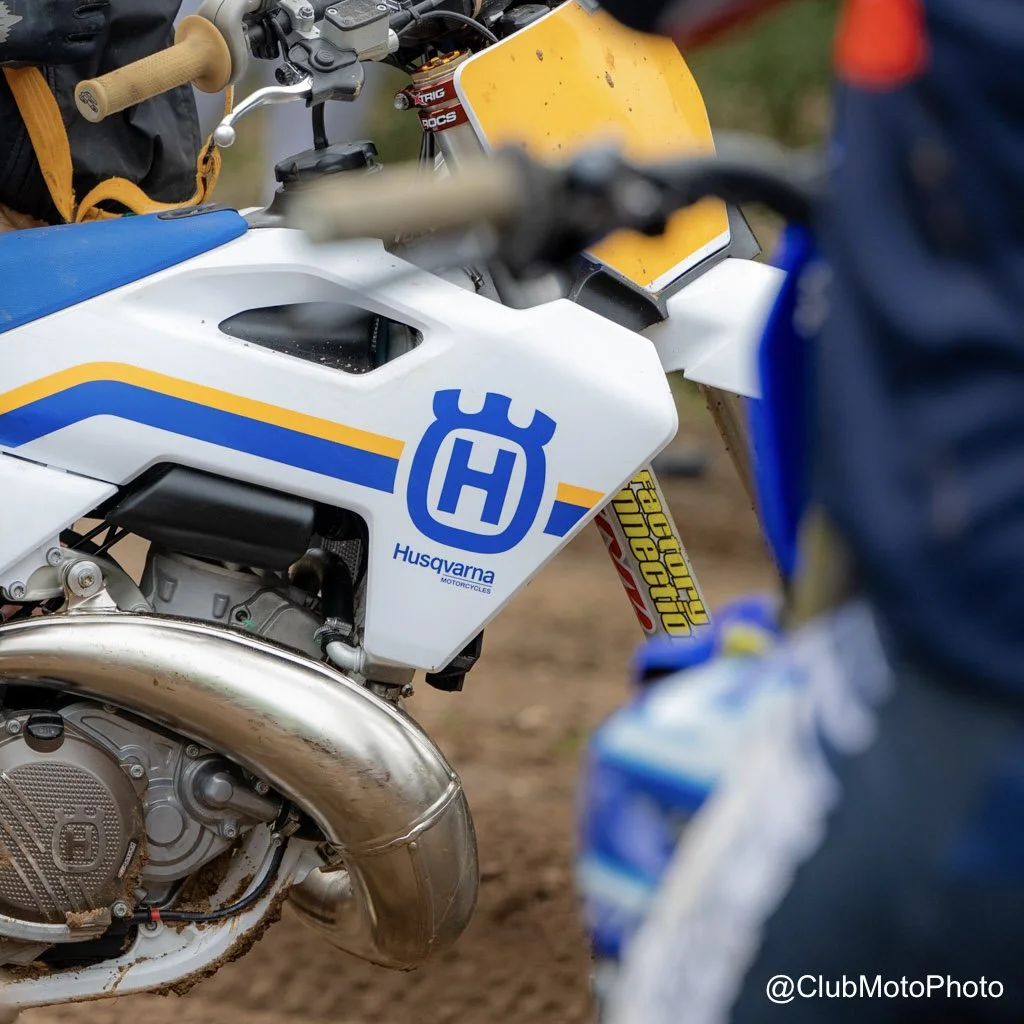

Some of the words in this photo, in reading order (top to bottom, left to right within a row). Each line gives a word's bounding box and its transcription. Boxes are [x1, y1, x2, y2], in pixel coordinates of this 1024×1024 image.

[412, 87, 446, 106] XTRIG
[422, 111, 457, 130] ROCS
[392, 542, 496, 585] Husqvarna
[440, 577, 492, 595] MOTORCYCLES
